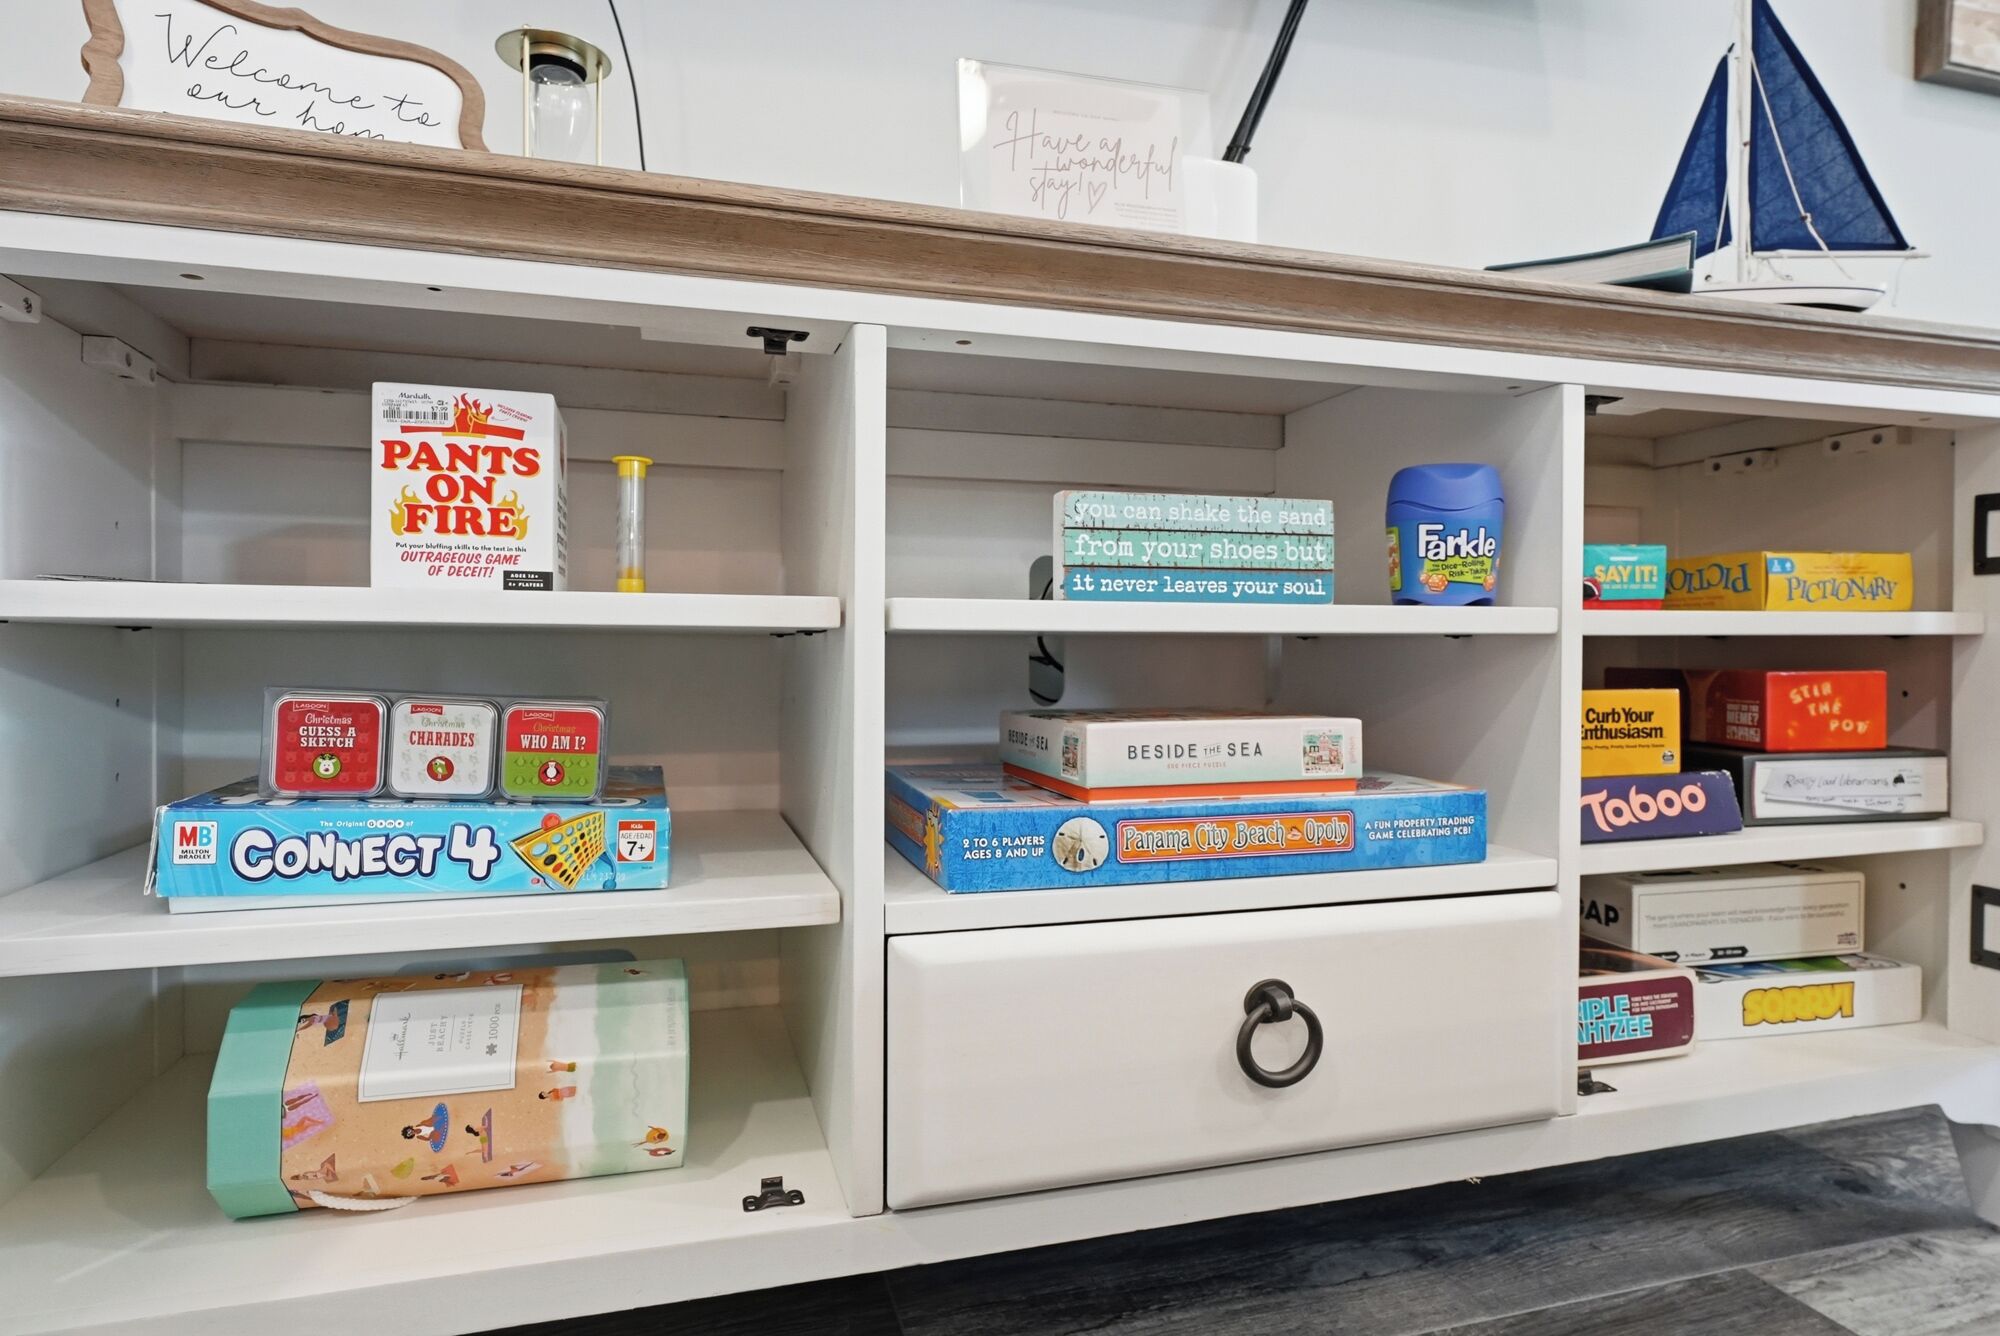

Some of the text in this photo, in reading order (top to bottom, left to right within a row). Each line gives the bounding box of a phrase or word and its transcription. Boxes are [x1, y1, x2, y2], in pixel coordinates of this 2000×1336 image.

[154, 14, 440, 127] Welcome to
[187, 82, 402, 143] our hom
[993, 108, 1119, 171] Have a
[1056, 136, 1178, 200] wonderful
[1030, 161, 1083, 220] stay!
[398, 392, 431, 400] Marshalls
[380, 439, 541, 478] PANTS
[425, 473, 497, 505] ON
[402, 503, 518, 538] FIRE
[1074, 502, 1327, 526] you can shake the sand
[408, 543, 424, 551] your
[425, 543, 453, 551] bluffing
[454, 543, 471, 551] skills
[1074, 535, 1327, 562] from your shoes but
[1417, 523, 1496, 561] Farkle
[401, 551, 521, 566] OUTRAGEOUS GAME
[1441, 560, 1485, 570] Dice-Rolling
[428, 565, 495, 578] OF DECEIT!
[1449, 568, 1488, 577] Risk-Taking
[1594, 565, 1658, 583] SAY IT!
[1666, 563, 1752, 595] PICTIO
[1072, 574, 1326, 598] it never leaves your soul
[1786, 576, 1898, 603] PICTIONARY
[1789, 681, 1833, 704] STIR
[1585, 708, 1654, 724] Curb Your
[1807, 699, 1841, 716] THE
[305, 713, 352, 725] Christmas
[421, 717, 466, 729] Christmas
[533, 722, 576, 734] Christmas
[1829, 720, 1869, 734] POT
[299, 726, 356, 736] GUESS A
[300, 737, 354, 747] SKETCH
[410, 731, 475, 747] CHARADES
[521, 734, 586, 750] WHO AM I?
[1008, 729, 1028, 746] BESIDE
[1036, 735, 1049, 751] SEA
[1127, 742, 1263, 760] BESIDE THE SEA
[1581, 784, 1706, 832] Taboo
[336, 820, 365, 828] Original
[1365, 816, 1475, 830] A FUN PROPERTY TRADING
[1368, 826, 1471, 840] GAME CELEBRATING PCB!
[179, 826, 212, 846] MB
[962, 836, 1045, 848] 2 TO 6 PLAYERS
[1124, 818, 1348, 854] Panama City Beach Opoly
[449, 823, 501, 881] 4
[627, 841, 646, 856] 7+
[963, 847, 1044, 860] AGES 8 AND UP
[1580, 897, 1619, 927] AP
[1578, 994, 1630, 1022] IPLE
[1742, 982, 1854, 1026] SORRY!
[393, 1013, 411, 1060] Hallmark
[428, 1023, 438, 1046] JUST
[437, 1015, 448, 1052] BEACHY
[488, 1016, 499, 1040] 1000
